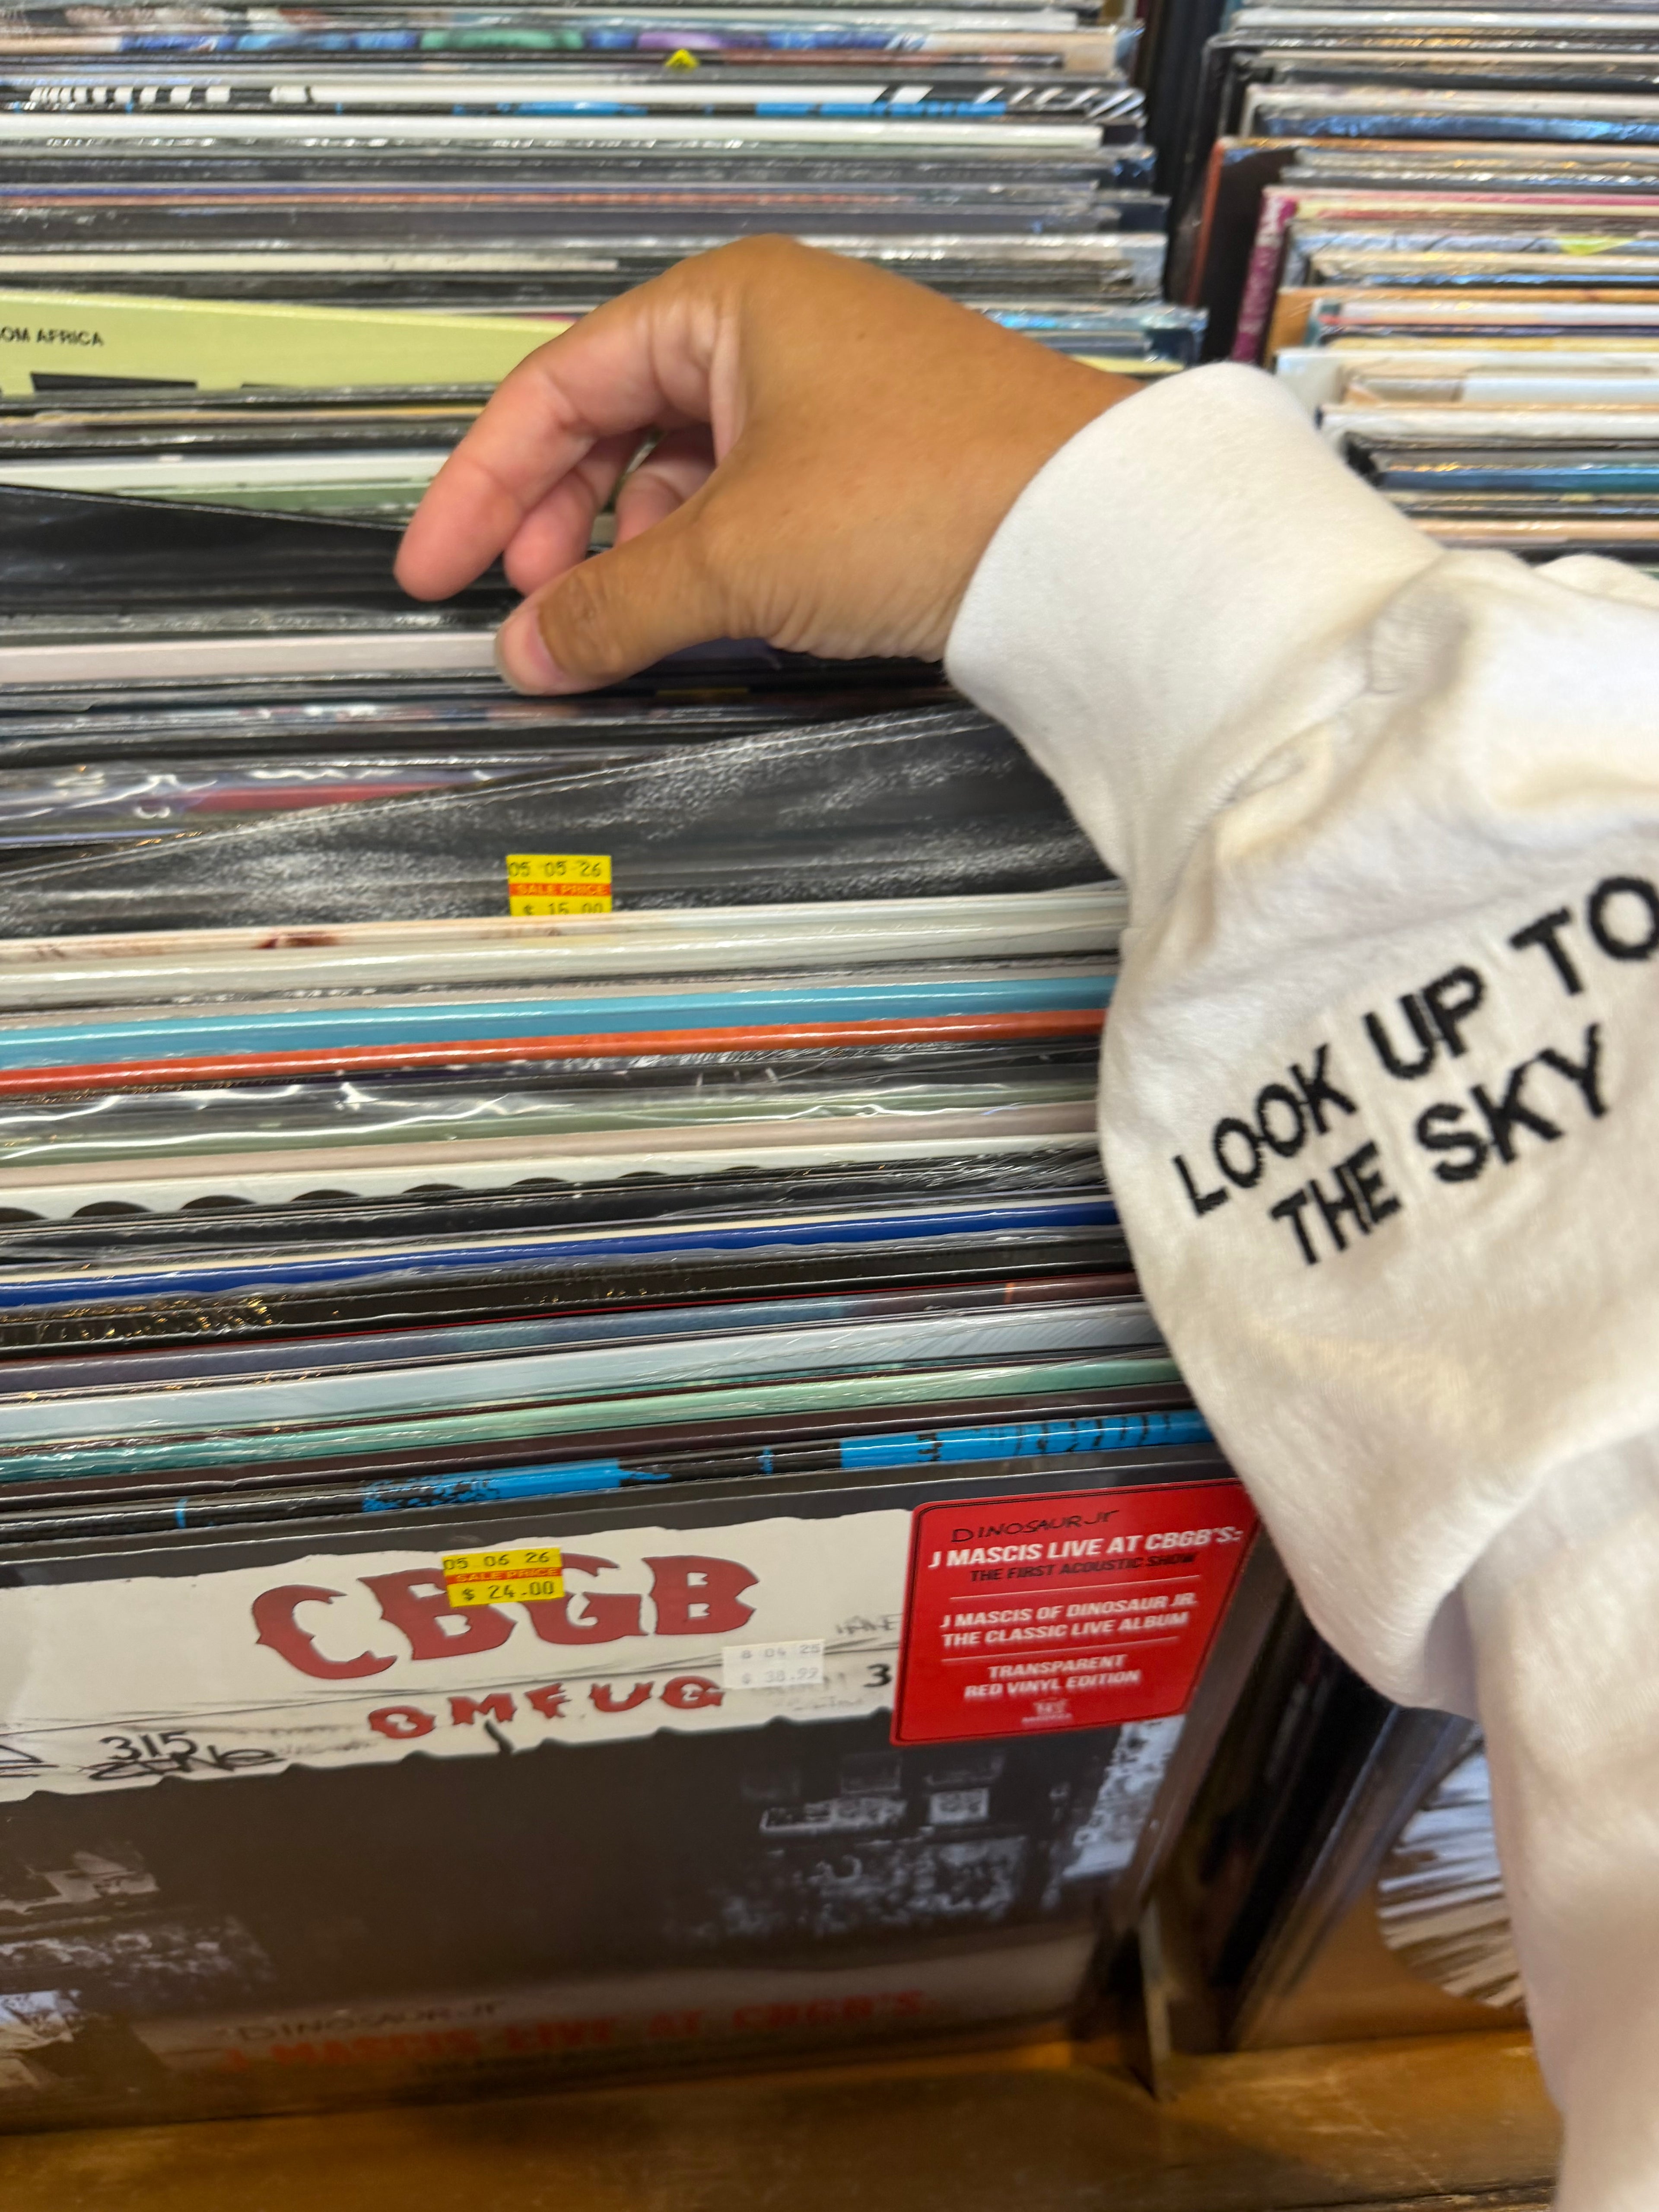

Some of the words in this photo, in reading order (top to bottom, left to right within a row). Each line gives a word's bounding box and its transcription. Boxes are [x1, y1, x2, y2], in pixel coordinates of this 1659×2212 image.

[36, 328, 104, 346] AFRICA
[508, 861, 531, 877] 05
[544, 861, 567, 877] 05
[577, 861, 601, 877] 26
[1173, 1043, 1357, 1216] LOOK
[1363, 965, 1485, 1079] UP
[1509, 876, 1659, 995] TO
[1269, 1141, 1404, 1265] THE
[1416, 1023, 1608, 1183] SKY
[951, 1516, 1082, 1543] DINOSAUR
[443, 1557, 468, 1570] 05
[484, 1554, 509, 1566] 06
[525, 1551, 550, 1563] 26
[928, 1551, 942, 1569] J
[946, 1544, 1044, 1567] MASCIS
[1046, 1538, 1104, 1559] LIVE
[1106, 1535, 1144, 1554] AT
[970, 1568, 1004, 1582] THE
[1007, 1564, 1056, 1579] FIRST
[1059, 1557, 1144, 1575] ACOUSTIC
[1147, 1552, 1198, 1567] SHOW
[456, 1571, 502, 1583] SALE
[506, 1567, 559, 1580] PRICE
[462, 1588, 475, 1601] $
[488, 1581, 554, 1599] 24.00
[252, 1553, 760, 1680] CBGB
[939, 1614, 952, 1628] J
[953, 1608, 1034, 1627] MASCIS
[1036, 1605, 1065, 1620] OF
[1066, 1595, 1169, 1617] DINOSAUR
[941, 1631, 982, 1647] THE
[984, 1624, 1068, 1643] CLASSIC
[1070, 1619, 1116, 1637] LIVE
[1117, 1611, 1189, 1631] ALBUM
[988, 1654, 1128, 1679] TRANSPARENT
[963, 1683, 1004, 1700] RED
[1006, 1677, 1062, 1695] VINYL
[1065, 1669, 1142, 1690] EDITION
[368, 1675, 725, 1739] OMFUG
[99, 1731, 197, 1761] 315
